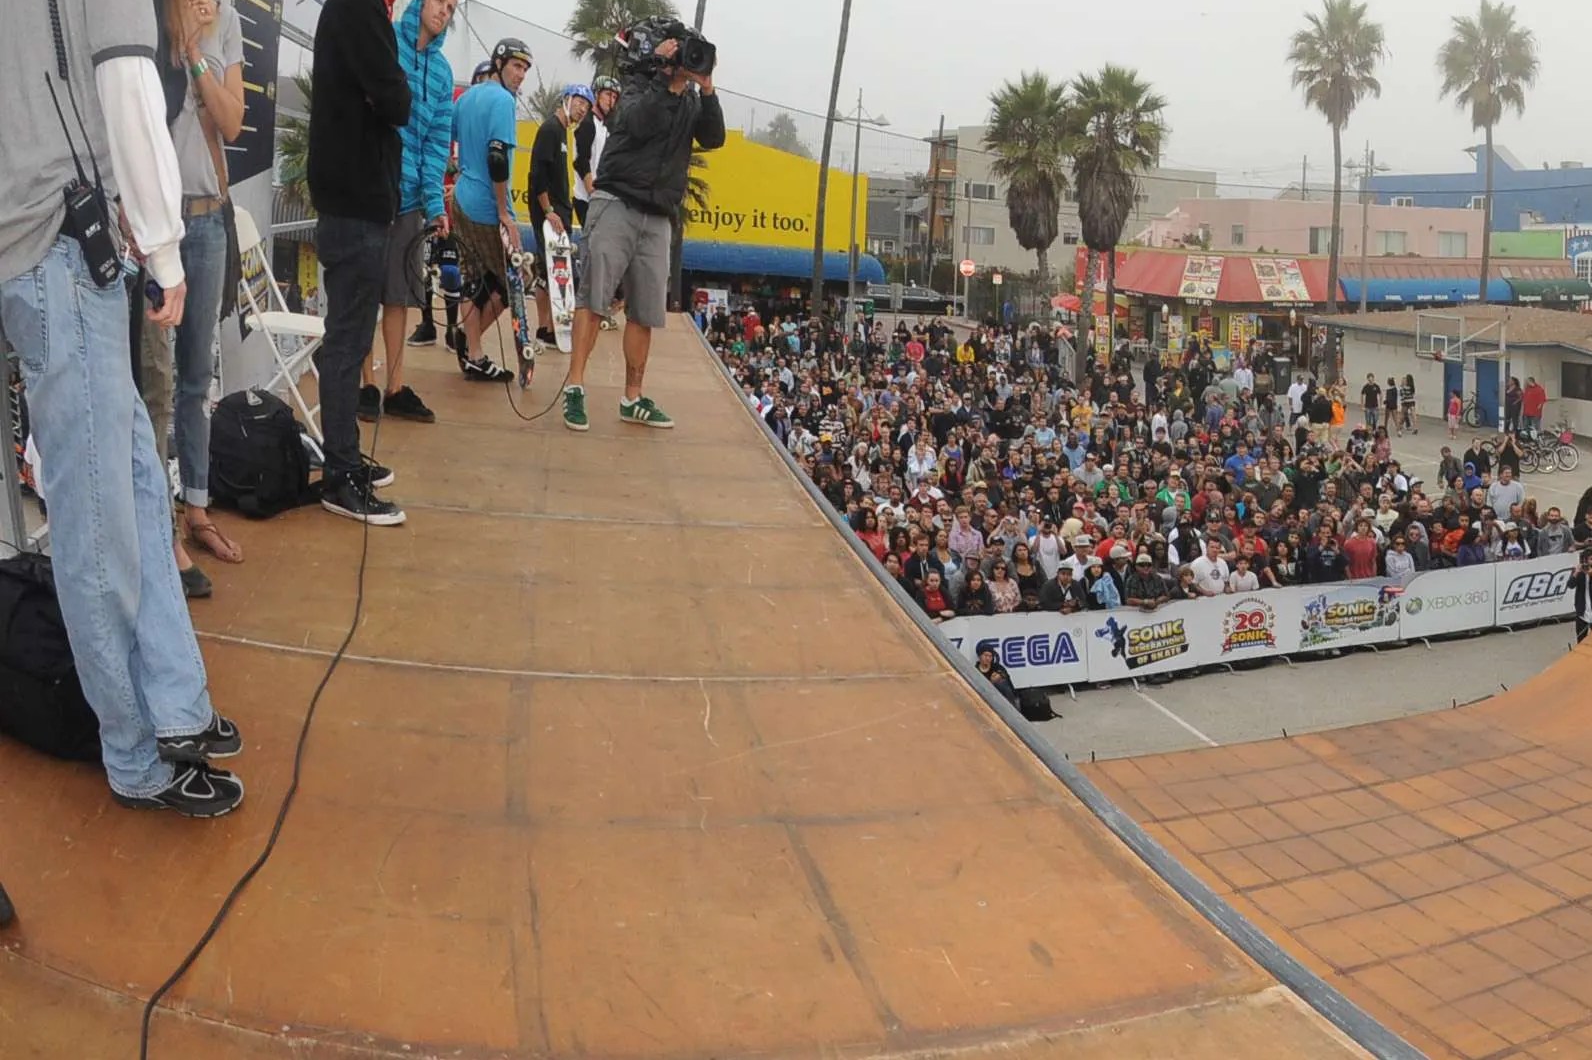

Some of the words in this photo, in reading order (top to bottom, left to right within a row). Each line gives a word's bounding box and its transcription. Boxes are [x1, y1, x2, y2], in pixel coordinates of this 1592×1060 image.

[689, 206, 746, 232] enjoy
[752, 209, 767, 228] it
[773, 212, 809, 232] too.
[1502, 567, 1578, 605] ASA
[1326, 601, 1375, 619] SONIC
[1426, 595, 1464, 611] XBOX
[1465, 590, 1490, 605] 360
[1128, 618, 1185, 644] SONIC
[1233, 610, 1266, 631] 20
[1230, 630, 1268, 644] SONIC
